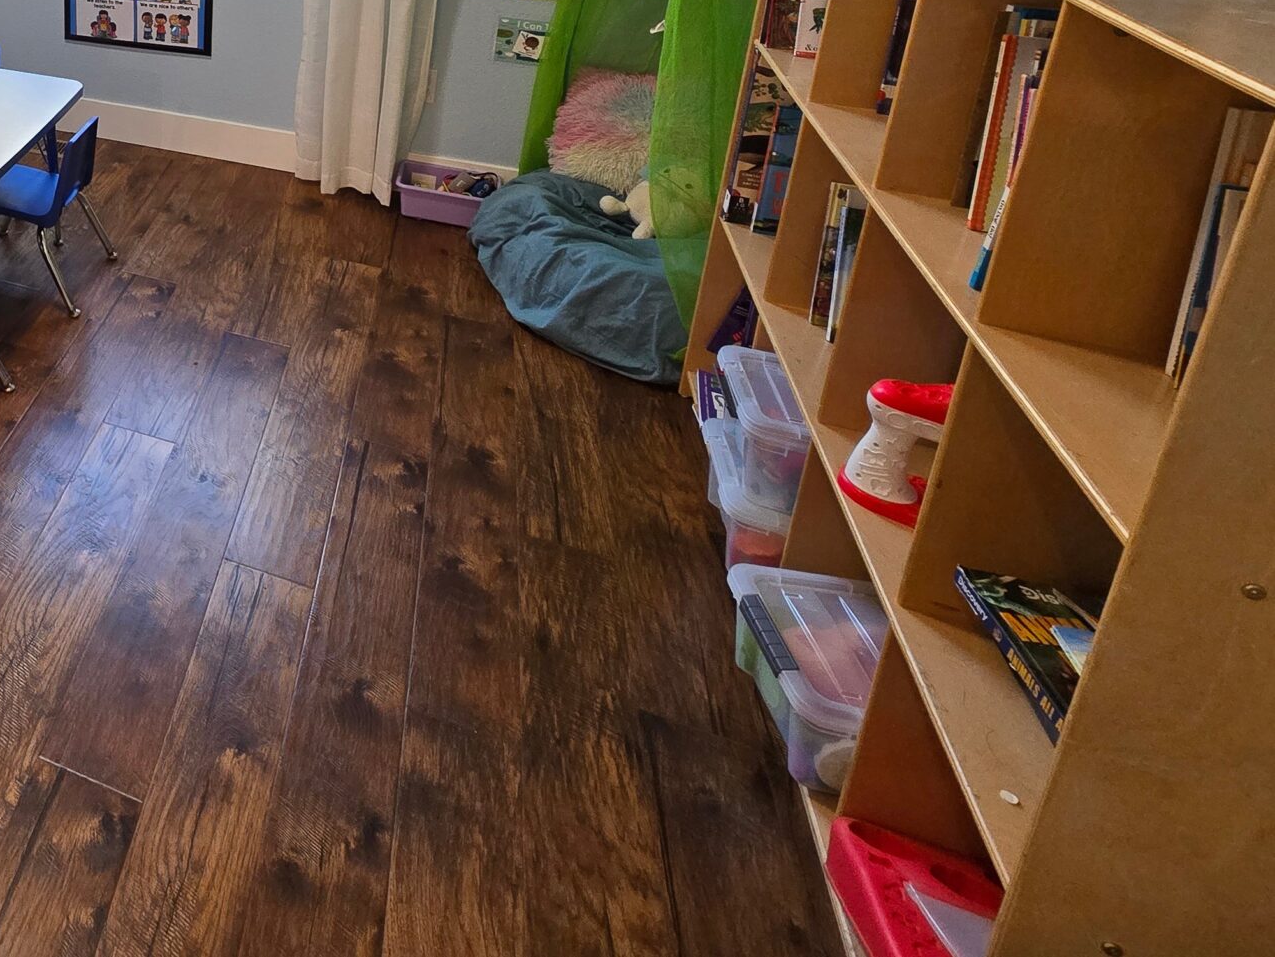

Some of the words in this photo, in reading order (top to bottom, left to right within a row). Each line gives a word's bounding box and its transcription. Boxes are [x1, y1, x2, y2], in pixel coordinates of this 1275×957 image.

[523, 21, 542, 31] Can
[956, 575, 988, 622] Discovery
[1006, 647, 1041, 699] ANIMALS
[1040, 695, 1055, 719] ALL
